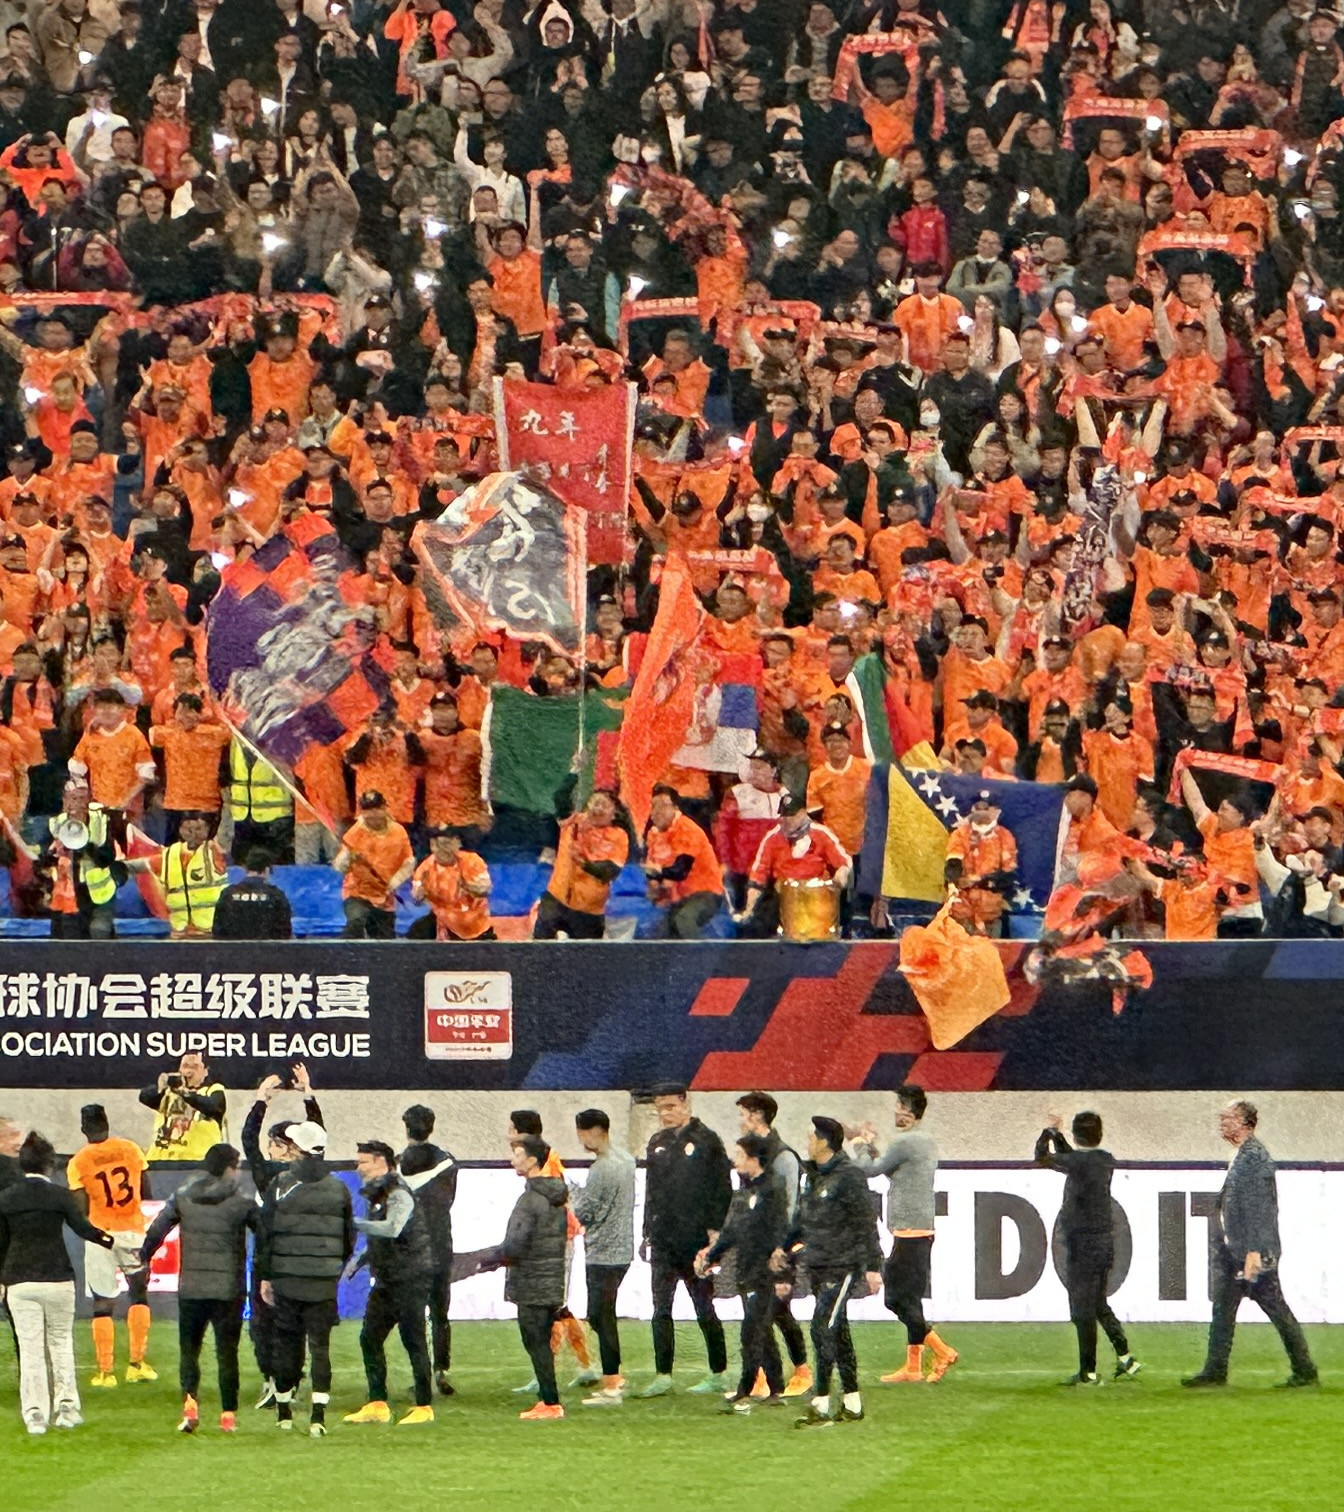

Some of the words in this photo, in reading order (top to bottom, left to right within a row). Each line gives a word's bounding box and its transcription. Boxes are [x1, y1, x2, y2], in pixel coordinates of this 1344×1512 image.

[146, 1032, 245, 1058] SUPER
[252, 1032, 370, 1058] LEAGUE
[94, 1165, 134, 1208] 13
